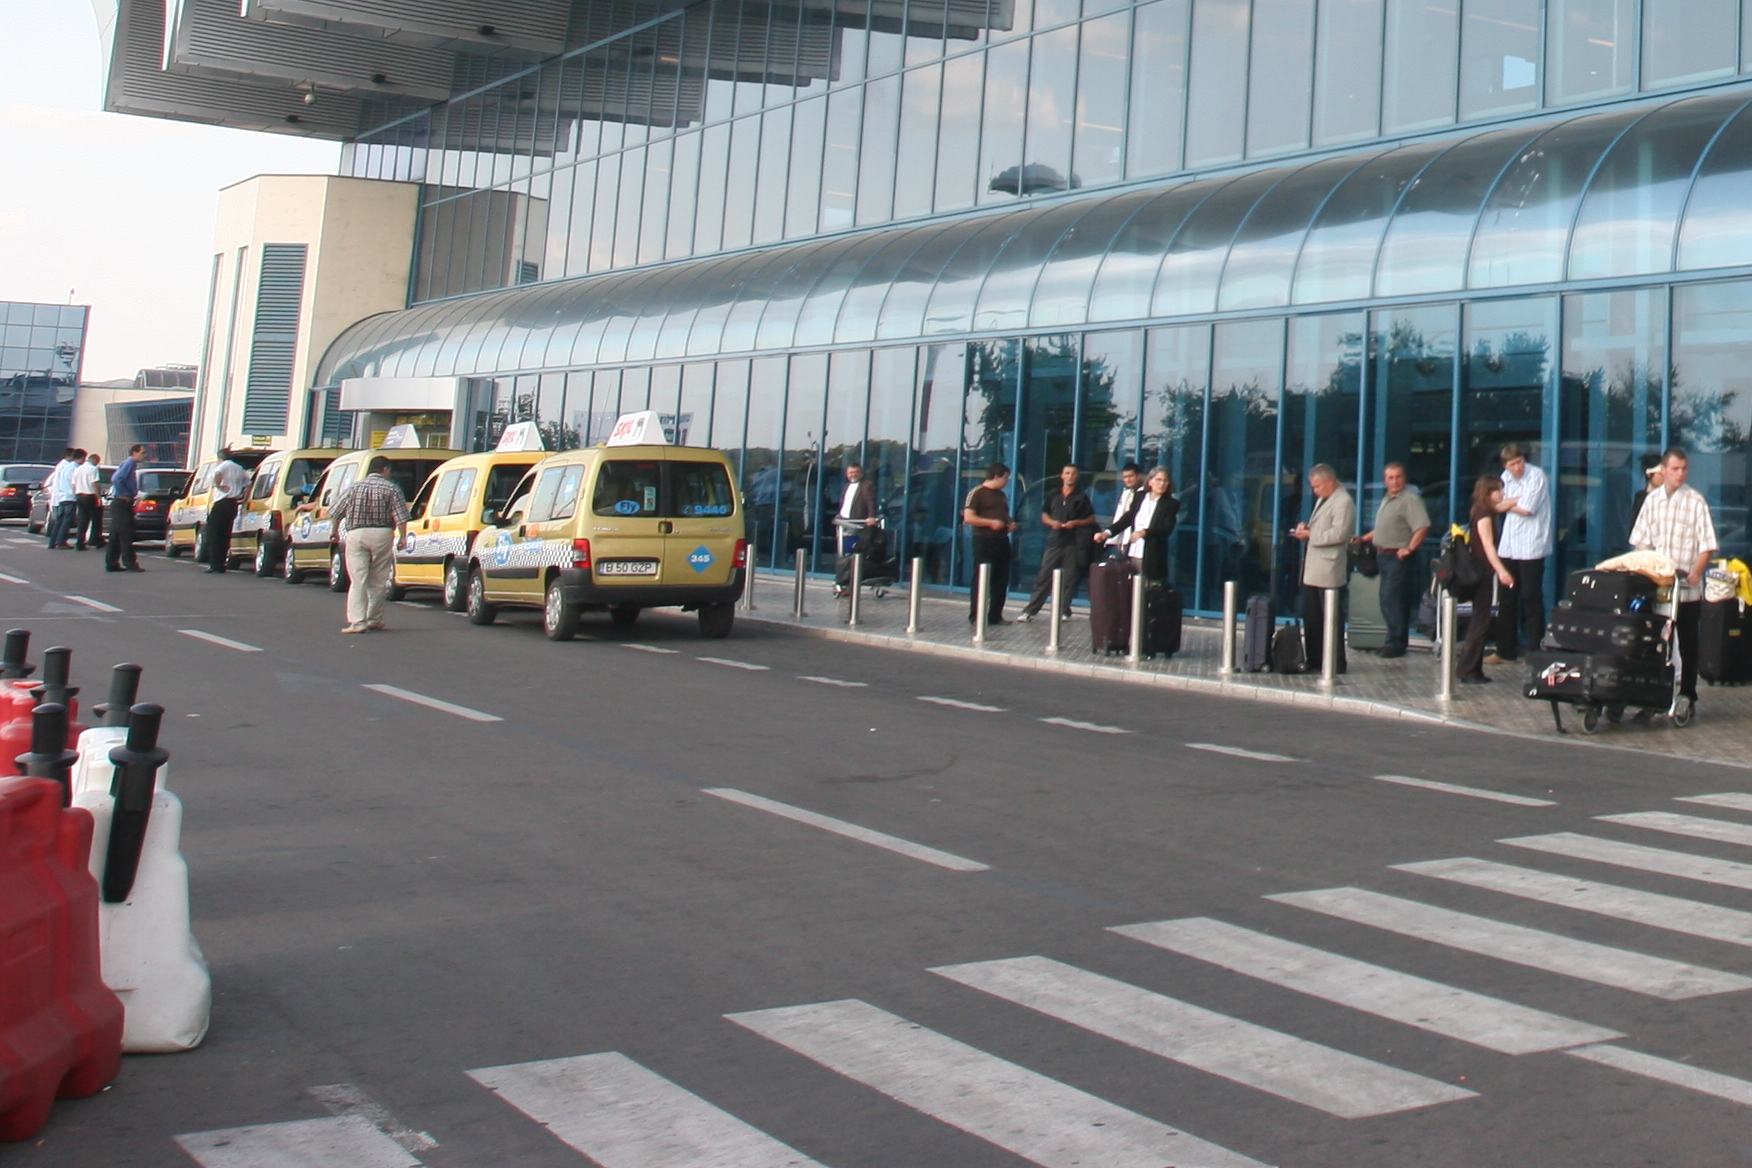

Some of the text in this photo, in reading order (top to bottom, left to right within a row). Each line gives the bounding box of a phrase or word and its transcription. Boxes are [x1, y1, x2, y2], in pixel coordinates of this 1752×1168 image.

[620, 500, 637, 512] Fly
[691, 554, 711, 563] 345
[616, 562, 628, 573] 50
[631, 562, 652, 573] GZP
